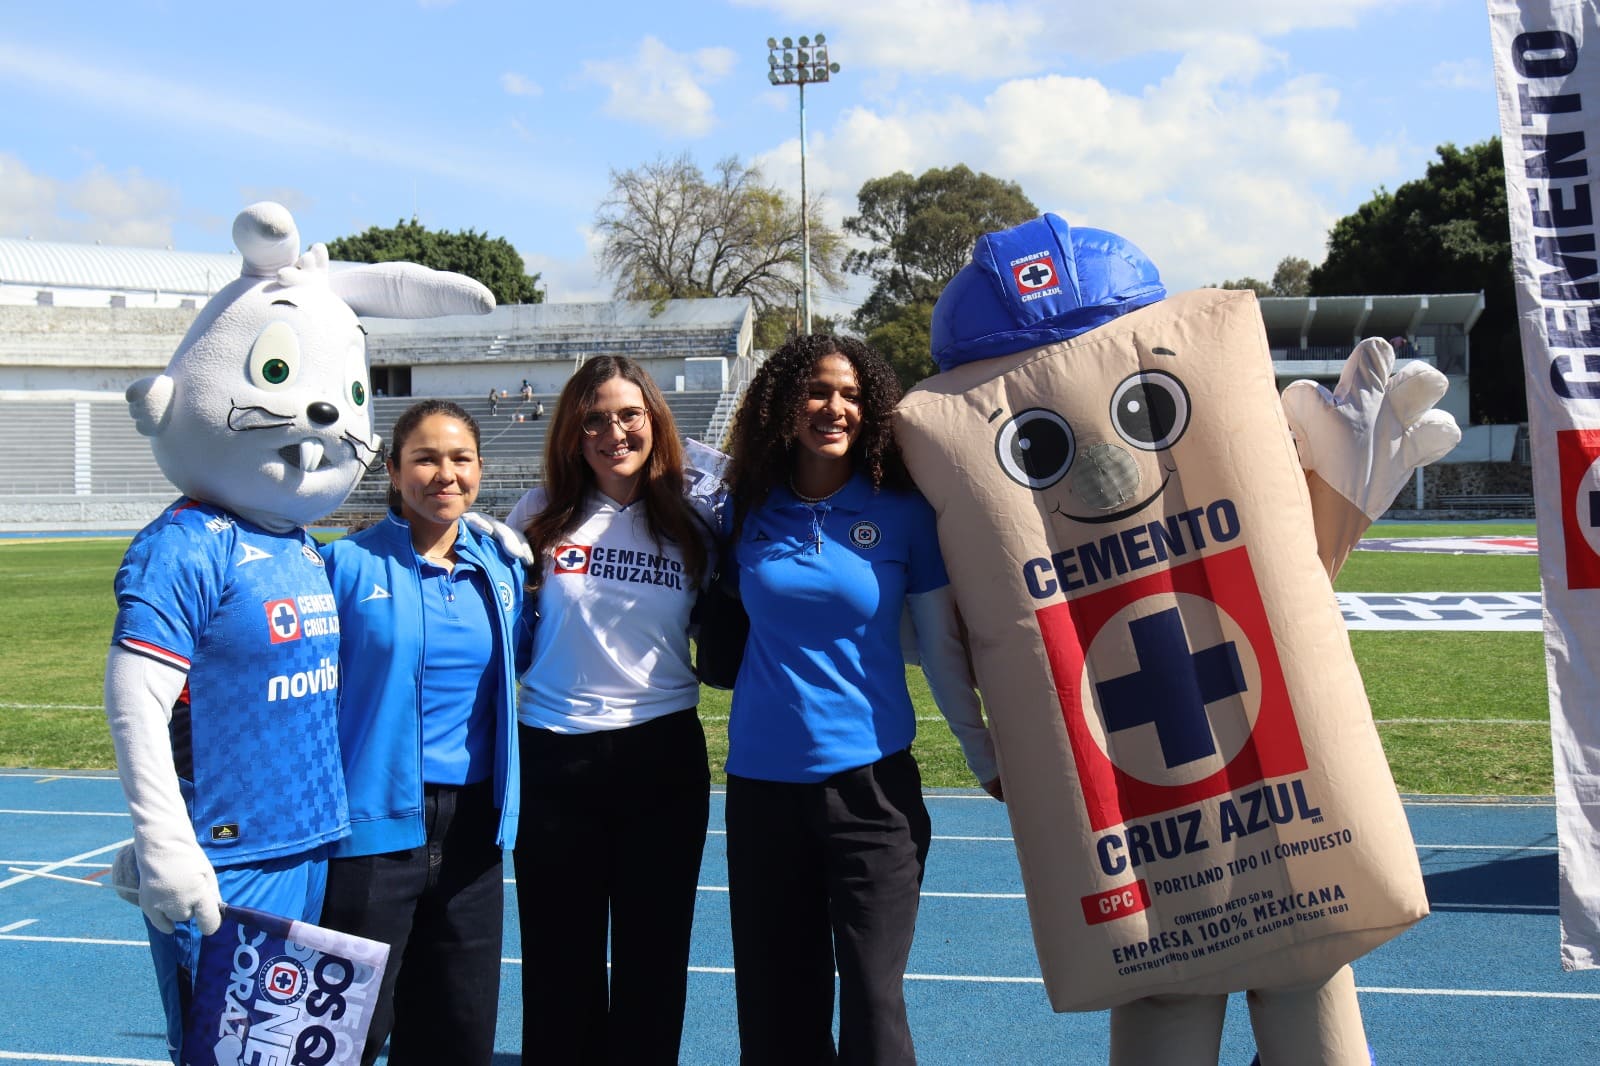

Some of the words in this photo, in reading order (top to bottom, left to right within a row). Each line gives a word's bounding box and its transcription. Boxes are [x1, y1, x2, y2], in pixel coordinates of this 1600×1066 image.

[1512, 31, 1600, 399] CEMENTO
[593, 547, 681, 573] CEMENTO
[1023, 498, 1241, 600] CEMENTO
[267, 657, 338, 701] novib
[1096, 808, 1209, 877] CRUZ
[1219, 779, 1321, 844] AZUL
[1154, 866, 1224, 895] PORTLAND
[1227, 855, 1258, 877] TIPO
[1275, 829, 1352, 859] COMPUESTO
[1099, 890, 1135, 914] CPC
[1112, 929, 1194, 964] EMPRESA
[1198, 912, 1247, 941] 100%
[1253, 884, 1345, 922] MEXICANA
[1174, 905, 1223, 925] CONTENIDO
[1225, 897, 1247, 912] NETO
[1248, 892, 1260, 903] 50
[1261, 890, 1273, 899] kg
[1118, 952, 1189, 976] CONSTRUYENDO
[1191, 948, 1205, 959] UN
[1242, 930, 1255, 940] DE
[1257, 917, 1294, 935] CALIDAD
[1296, 909, 1326, 921] DESDE
[1328, 903, 1349, 915] 1881
[306, 952, 354, 1022] OS
